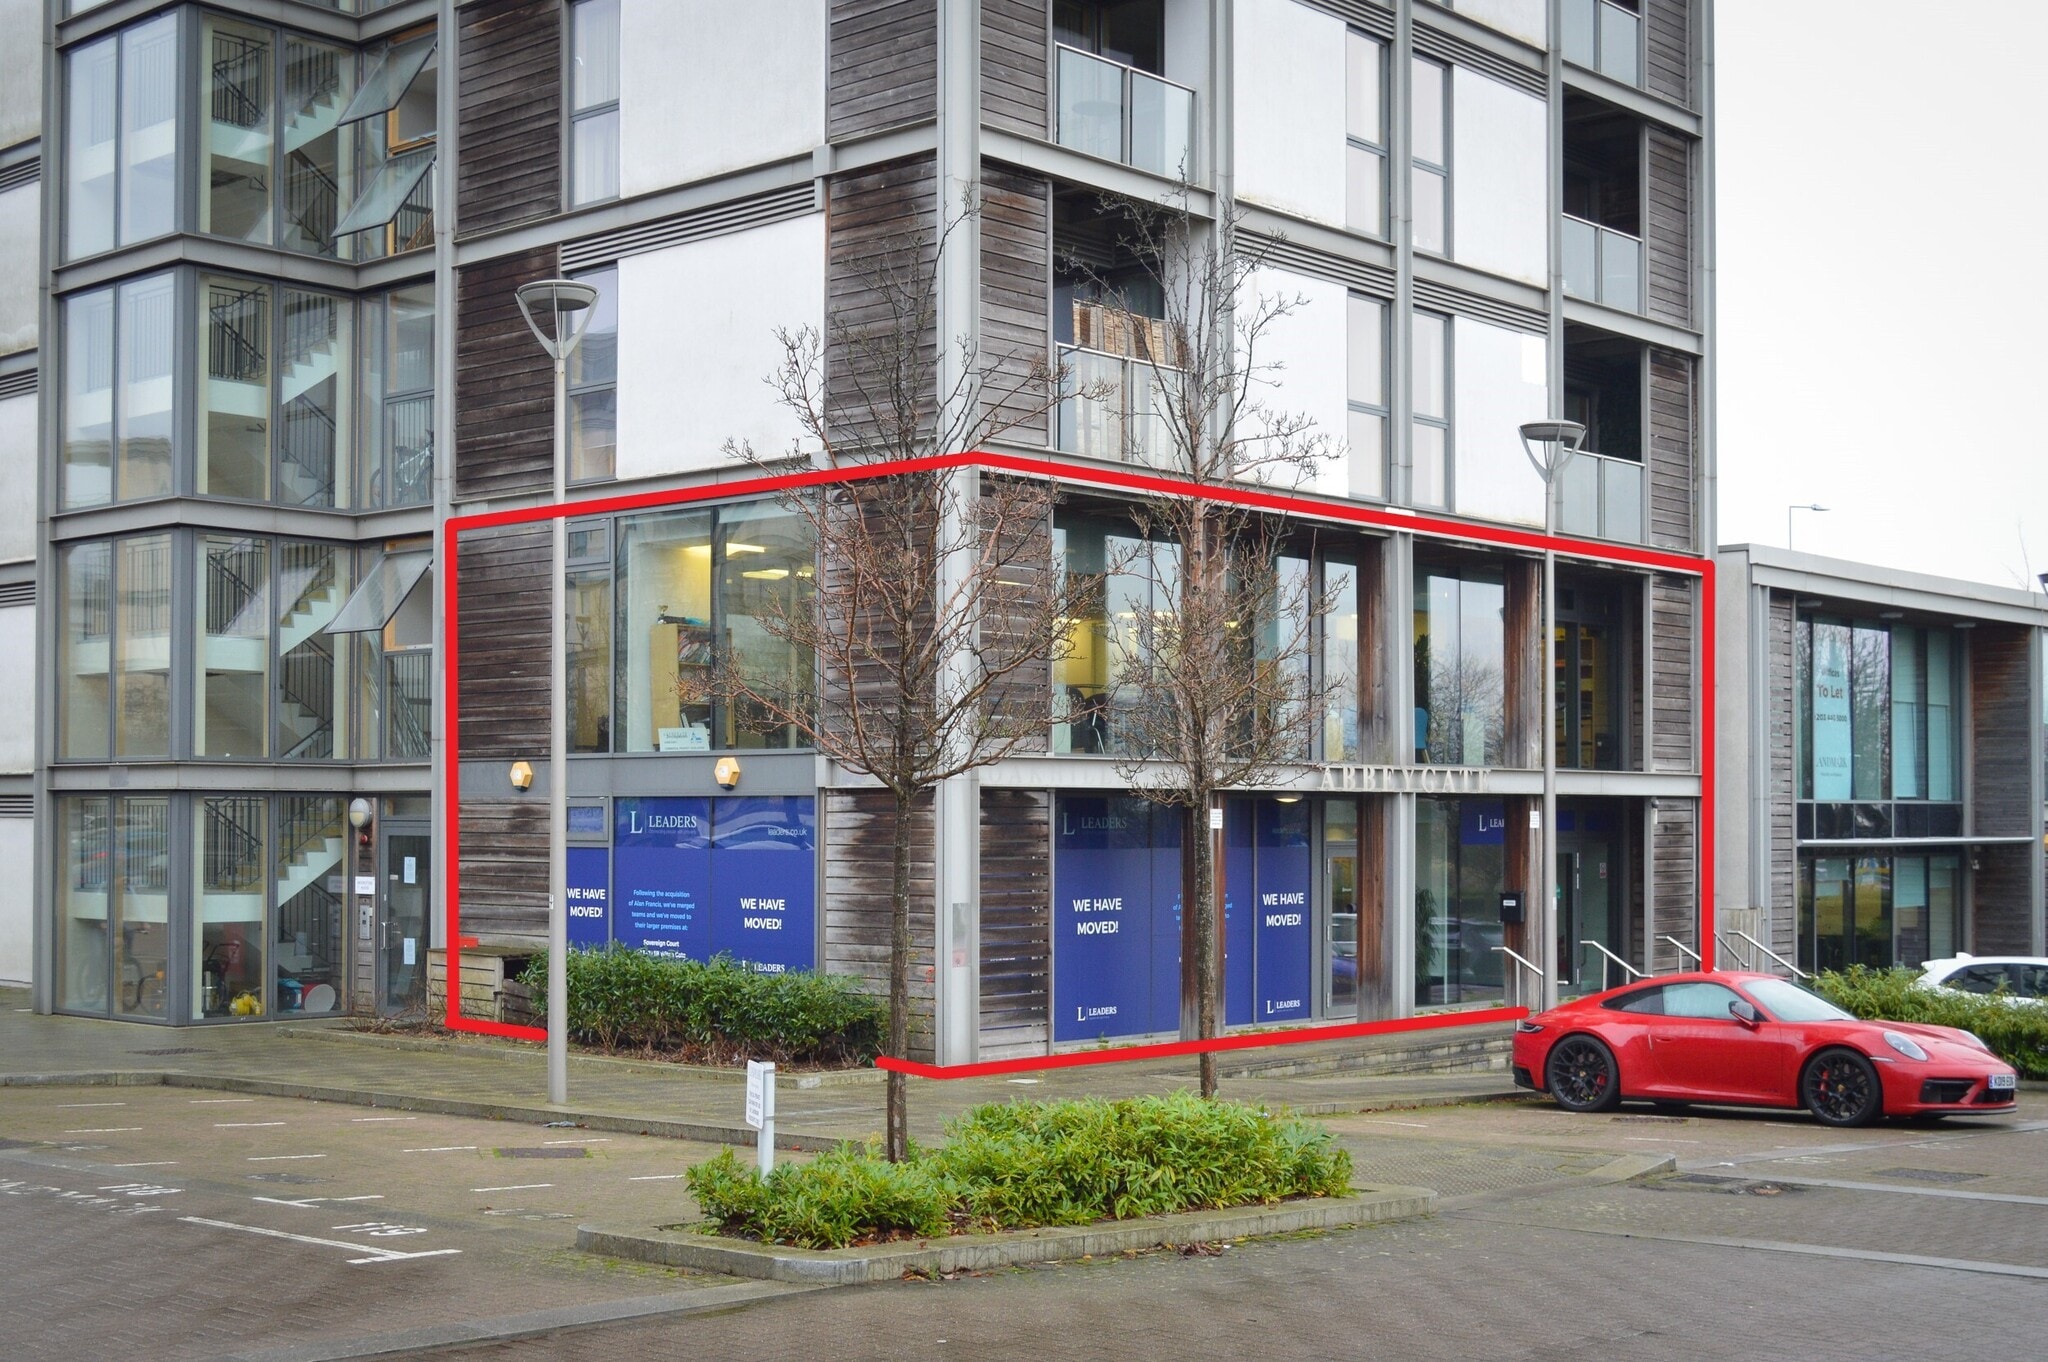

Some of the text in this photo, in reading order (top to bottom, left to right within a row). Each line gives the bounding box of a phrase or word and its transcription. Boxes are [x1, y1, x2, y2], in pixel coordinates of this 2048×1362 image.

[1816, 685, 1843, 699] To Let
[1816, 757, 1848, 768] ANDMARK
[1319, 766, 1491, 793] ABBEYGATE
[630, 810, 697, 834] L LEADERS
[1062, 812, 1127, 835] L LEADERS
[1478, 814, 1487, 832] L
[567, 888, 606, 901] WE HAVE
[633, 889, 656, 898] Following
[665, 890, 690, 898] acquisition
[1262, 892, 1304, 906] WE HAVE
[676, 902, 695, 910] merged
[740, 897, 785, 911] WE HAVE
[1073, 897, 1122, 912] WE HAVE
[569, 906, 603, 918] MOVED!
[646, 922, 660, 930] larger
[744, 917, 782, 930] MOVED!
[1265, 913, 1301, 927] MOVED!
[1077, 921, 1119, 935] MOVED!
[643, 939, 680, 948] Sovereign Court
[754, 963, 786, 973] LEADERS
[1077, 1006, 1117, 1021] L LEADERS
[1267, 1000, 1300, 1014] L LEADERS
